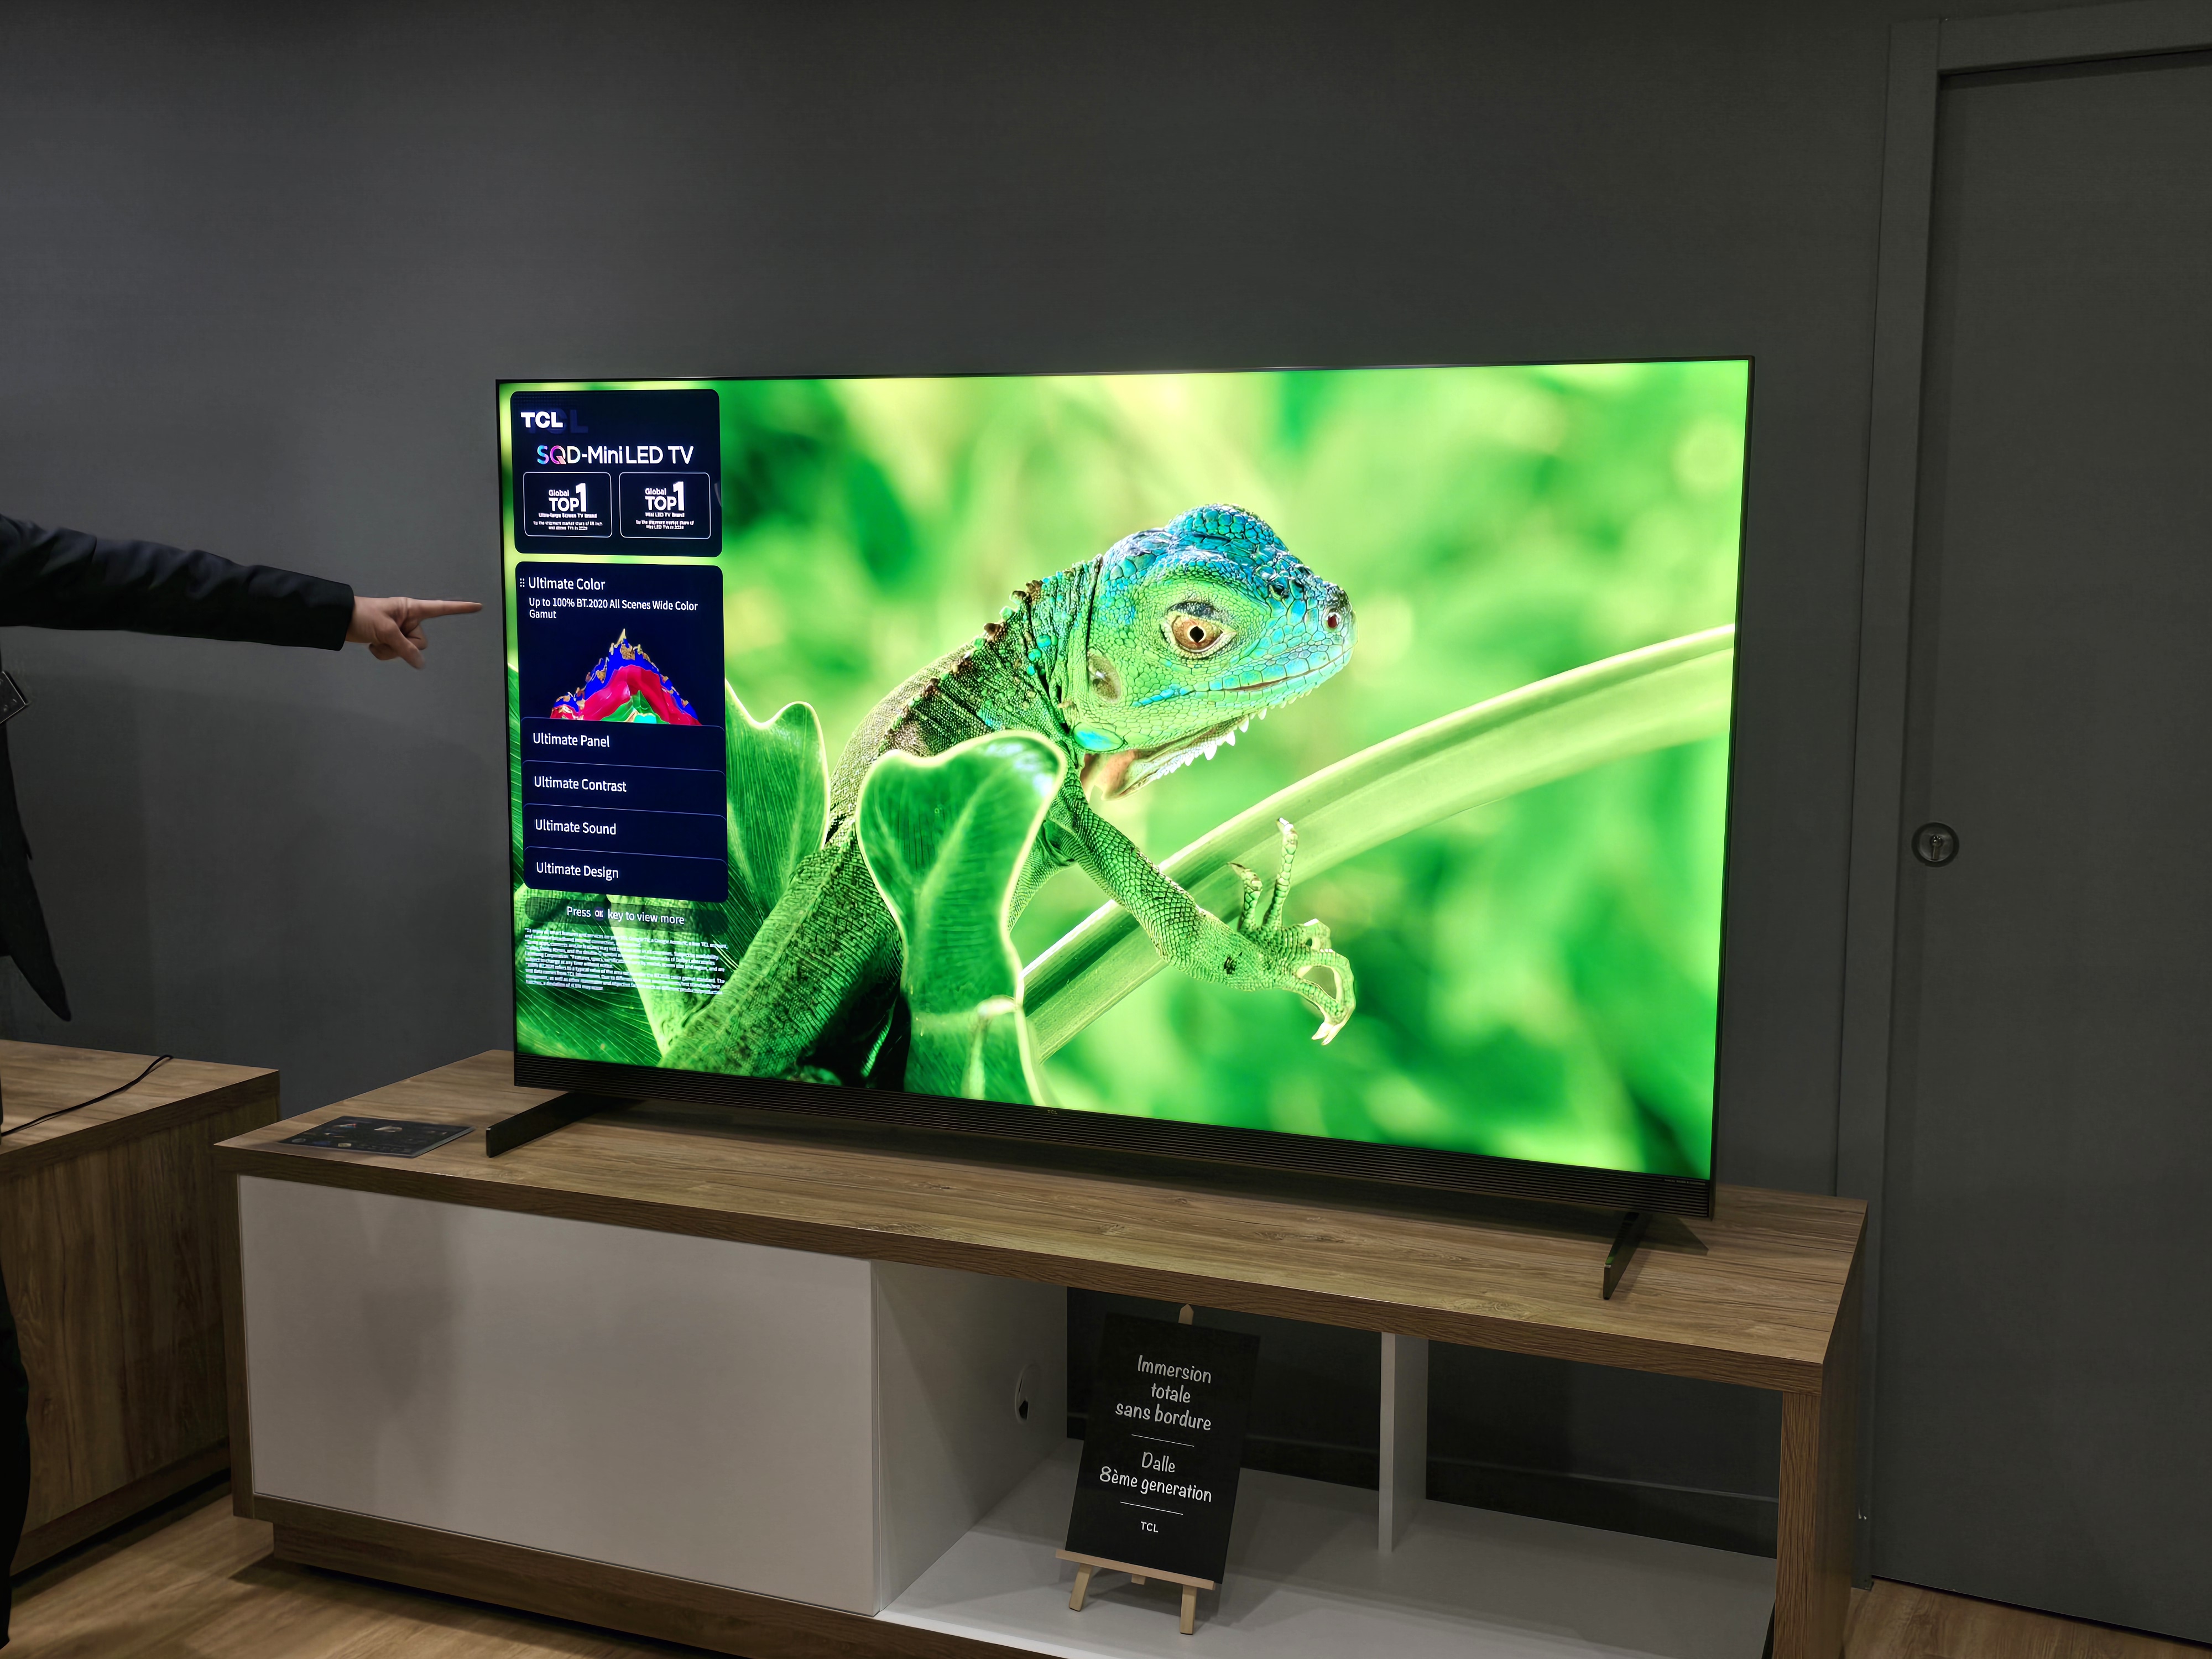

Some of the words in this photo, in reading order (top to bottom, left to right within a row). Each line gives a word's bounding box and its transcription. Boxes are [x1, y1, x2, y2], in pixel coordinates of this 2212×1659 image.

[521, 411, 563, 428] TCL
[668, 446, 693, 464] TV
[549, 497, 579, 512] TOP
[576, 483, 587, 512] 1
[645, 496, 677, 510] TOP
[672, 481, 685, 511] 1
[529, 577, 573, 589] Ultimate
[577, 578, 605, 589] Color
[529, 597, 540, 608] Up
[553, 598, 575, 607] 100%
[577, 599, 608, 608] BT.2020
[610, 599, 619, 608] All
[622, 600, 650, 609] Scenes
[653, 601, 673, 610] Wide
[675, 601, 698, 611] Color
[530, 609, 556, 618] Gamut
[534, 733, 578, 745] Ultimate
[581, 735, 609, 747] Panel
[535, 776, 578, 789] Ultimate
[582, 779, 627, 792] Contrast
[536, 819, 580, 832] Ultimate
[583, 822, 615, 834] Sound
[537, 862, 581, 875] Ultimate
[584, 865, 618, 881] Design
[567, 906, 592, 918] Press
[608, 909, 623, 922] key
[625, 912, 635, 921] to
[637, 911, 658, 923] view
[660, 915, 685, 925] more
[1138, 1355, 1211, 1384] Immersion
[1151, 1383, 1191, 1403] totale
[1115, 1404, 1150, 1420] sans
[1155, 1404, 1211, 1431] bordure
[1142, 1452, 1175, 1472] Dalle
[1100, 1466, 1138, 1487] 8ème
[1140, 1479, 1211, 1502] generation
[1141, 1521, 1158, 1532] TCL
